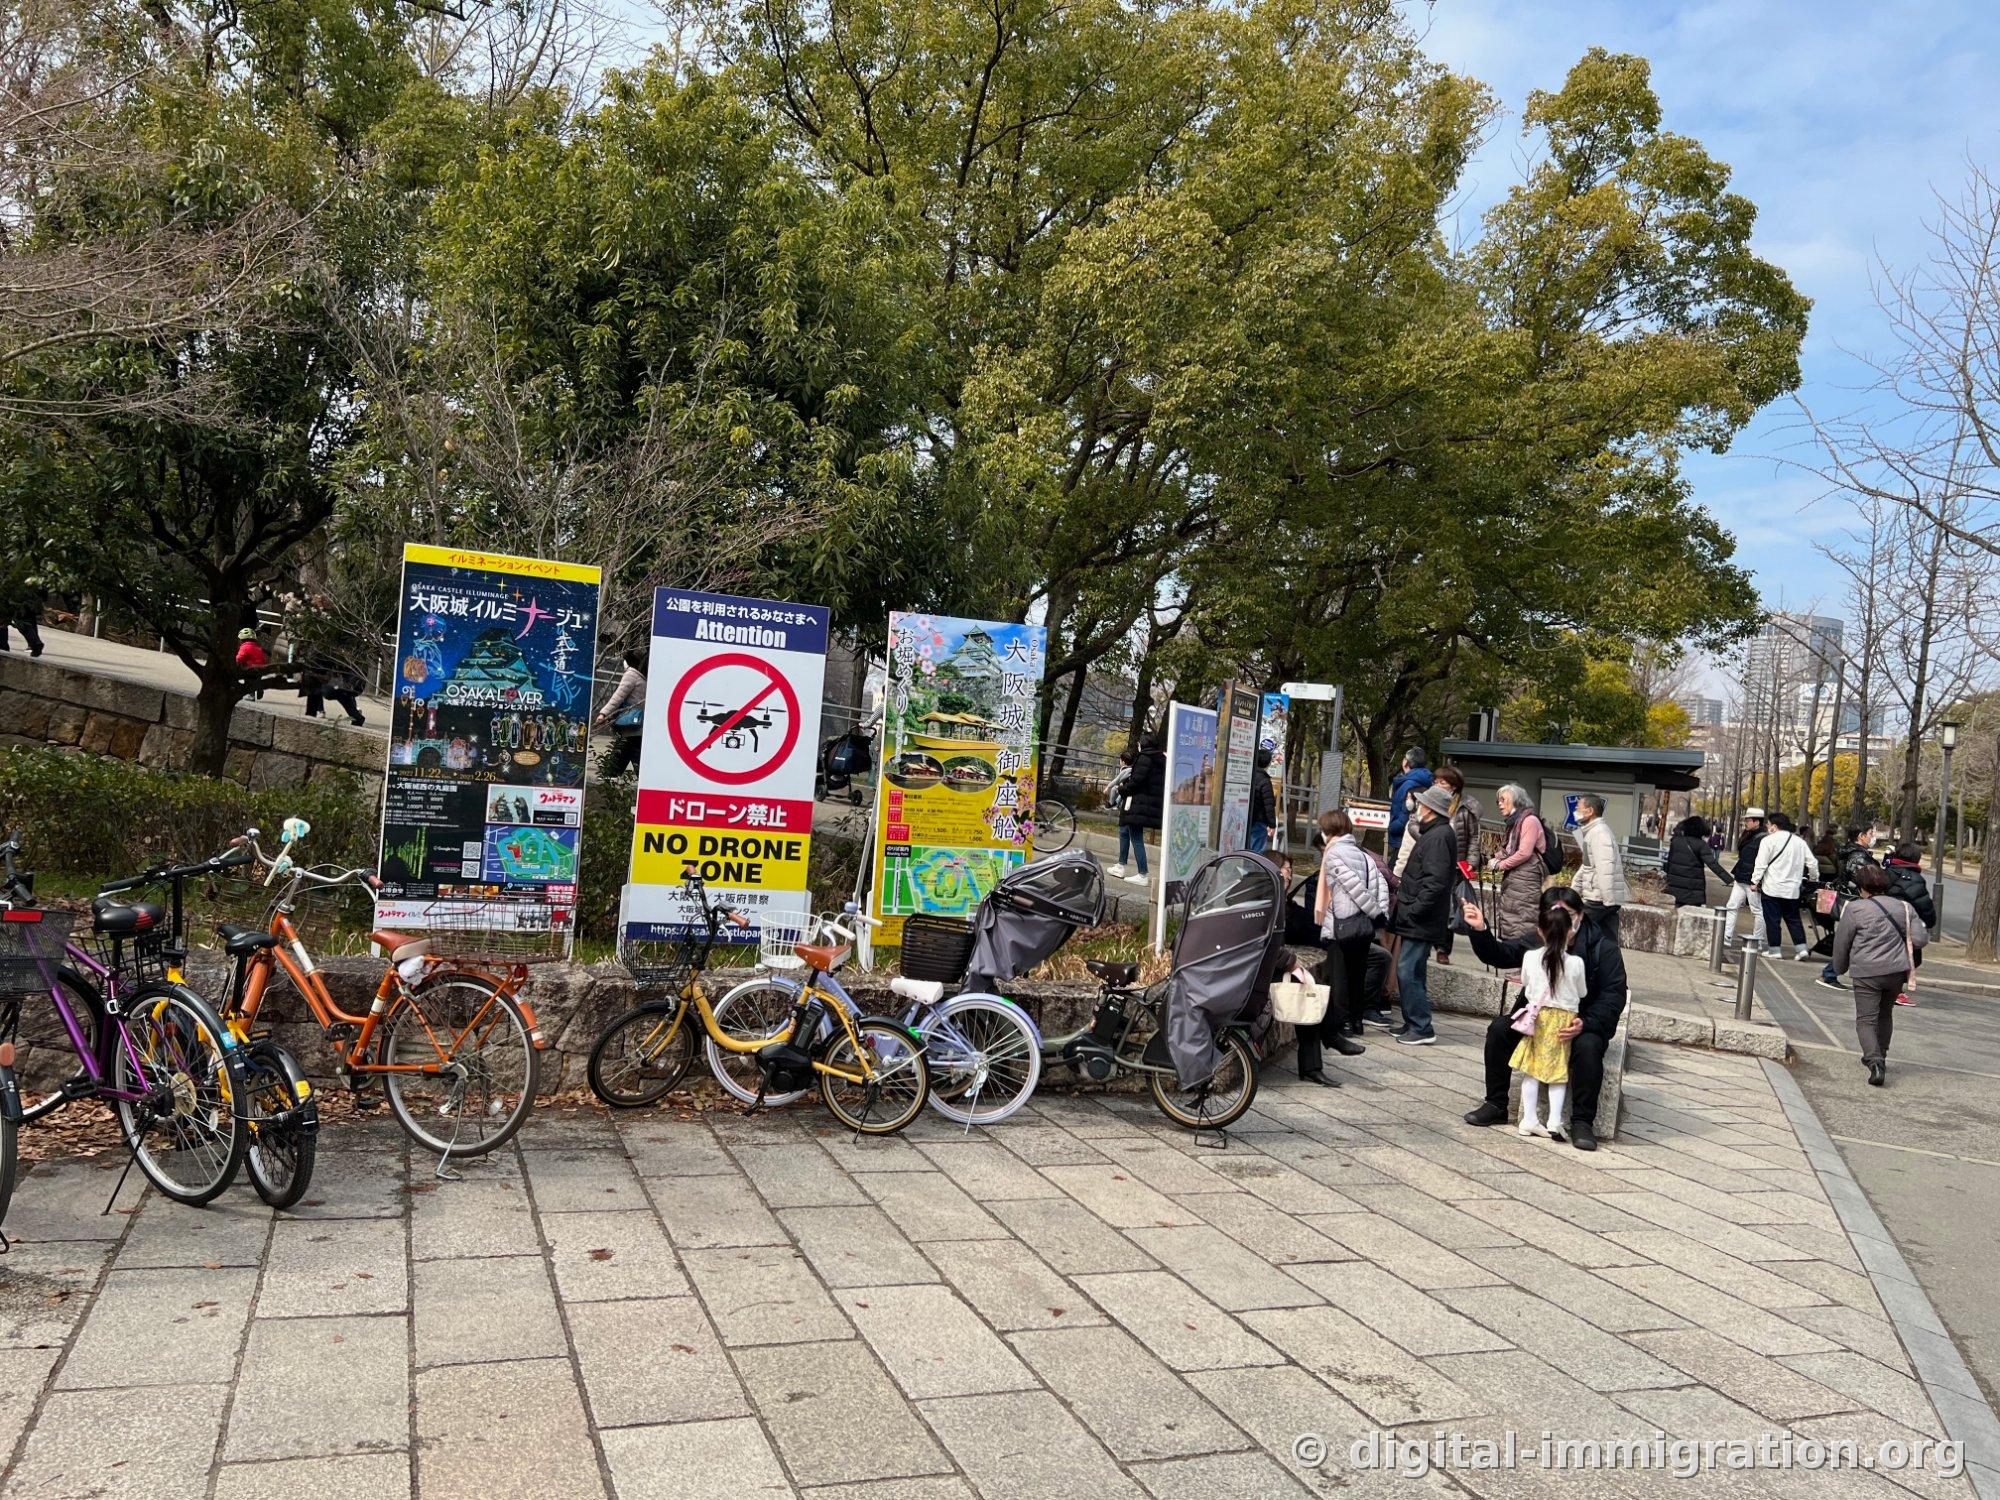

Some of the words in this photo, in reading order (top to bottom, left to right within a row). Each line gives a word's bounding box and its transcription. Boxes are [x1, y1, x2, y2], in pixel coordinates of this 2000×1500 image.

[448, 553, 561, 575] イルミネーションイベント
[411, 583, 436, 593] OSAKA
[438, 586, 464, 595] CASTLE
[466, 589, 510, 600] ILLUMINAGE
[409, 592, 583, 641] 大阪城イルミナージュ
[666, 597, 818, 626] 公園を利用されるみなさまへ
[695, 618, 787, 649] Attention
[1030, 639, 1038, 668] Osaka
[897, 627, 914, 715] お堀めぐり
[446, 685, 495, 702] OSAKA
[992, 638, 1028, 840] 大阪城御座船
[414, 767, 441, 778] 11.22
[474, 771, 496, 782] 2.26
[540, 793, 576, 804] ウルトラマン
[668, 797, 788, 828] ドローン禁止
[643, 832, 688, 854] NO
[698, 835, 802, 861] DRONE
[680, 859, 763, 884] ZONE
